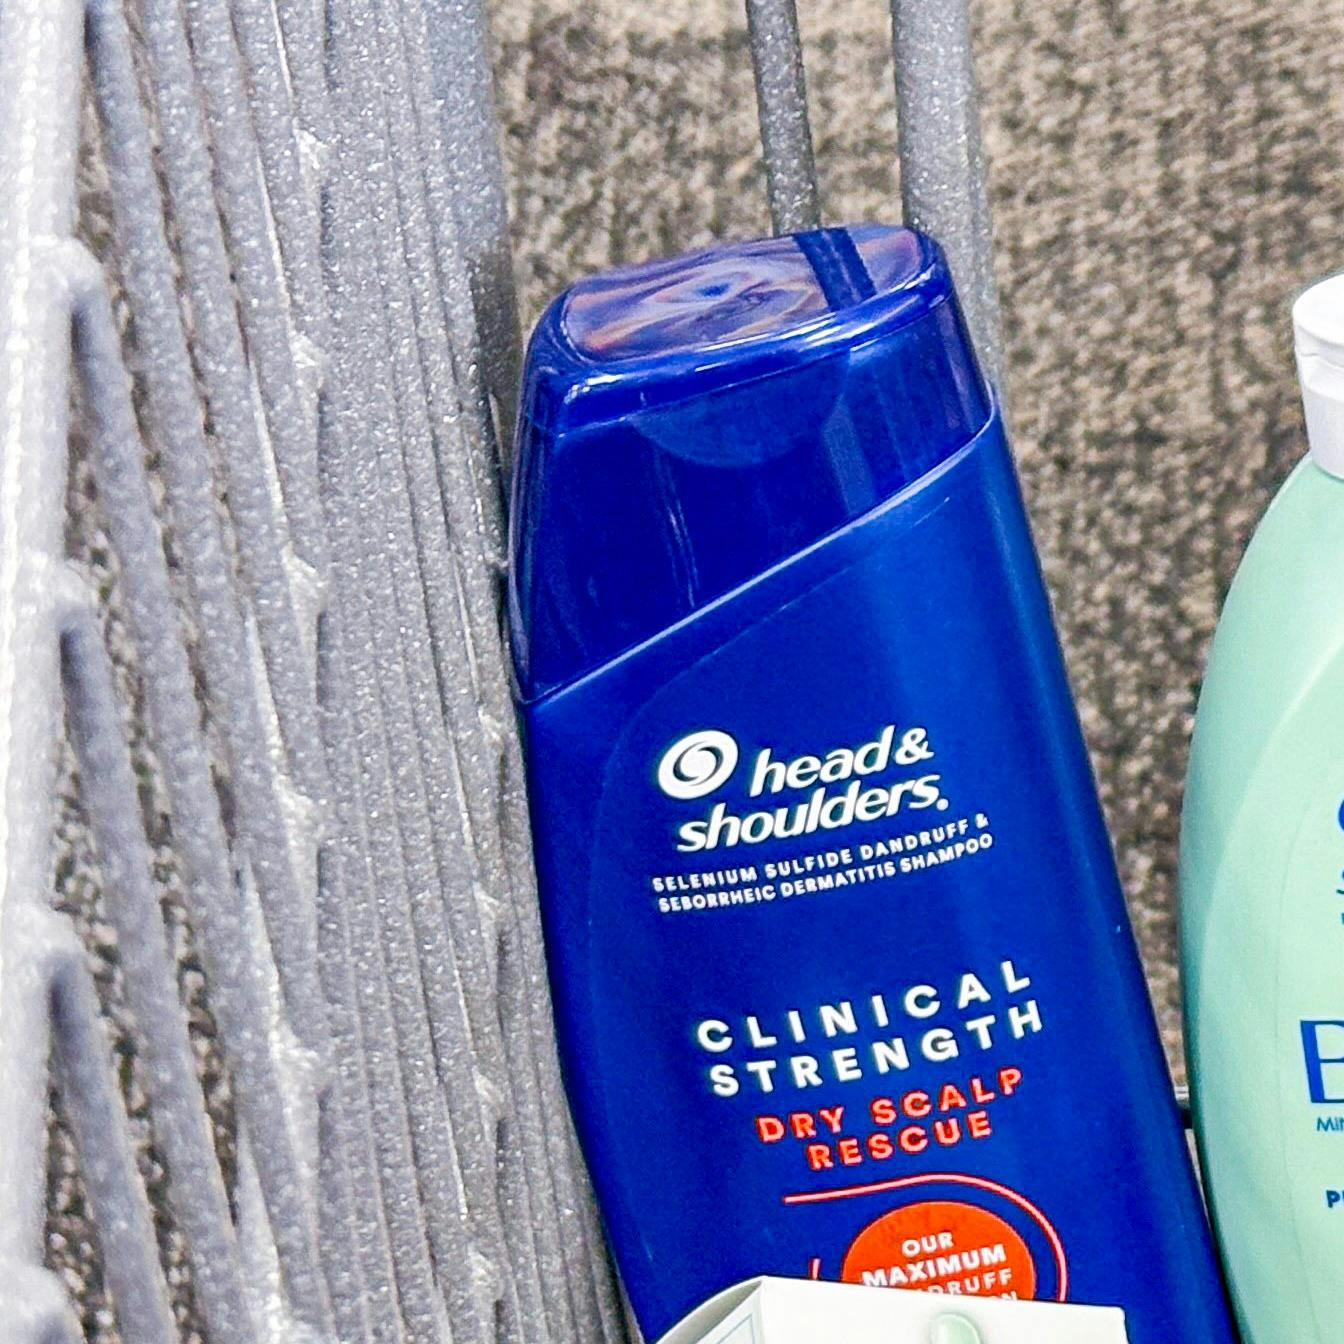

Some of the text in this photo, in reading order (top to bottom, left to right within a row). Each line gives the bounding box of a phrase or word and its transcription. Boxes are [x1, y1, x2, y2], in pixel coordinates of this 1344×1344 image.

[652, 818, 969, 893] SELENIUM SULFIDE DANDRUFF
[658, 833, 993, 913] SEBORRHEIC DERMATITIS SHAMPOO
[697, 960, 1031, 1052] CLINICAL
[710, 999, 1042, 1096] STRENGTH
[756, 1067, 1023, 1144] DRY SCALP
[807, 1111, 993, 1170] RESCUE
[861, 1244, 1006, 1287] MAXIMUM
[902, 1232, 954, 1257] OUR
